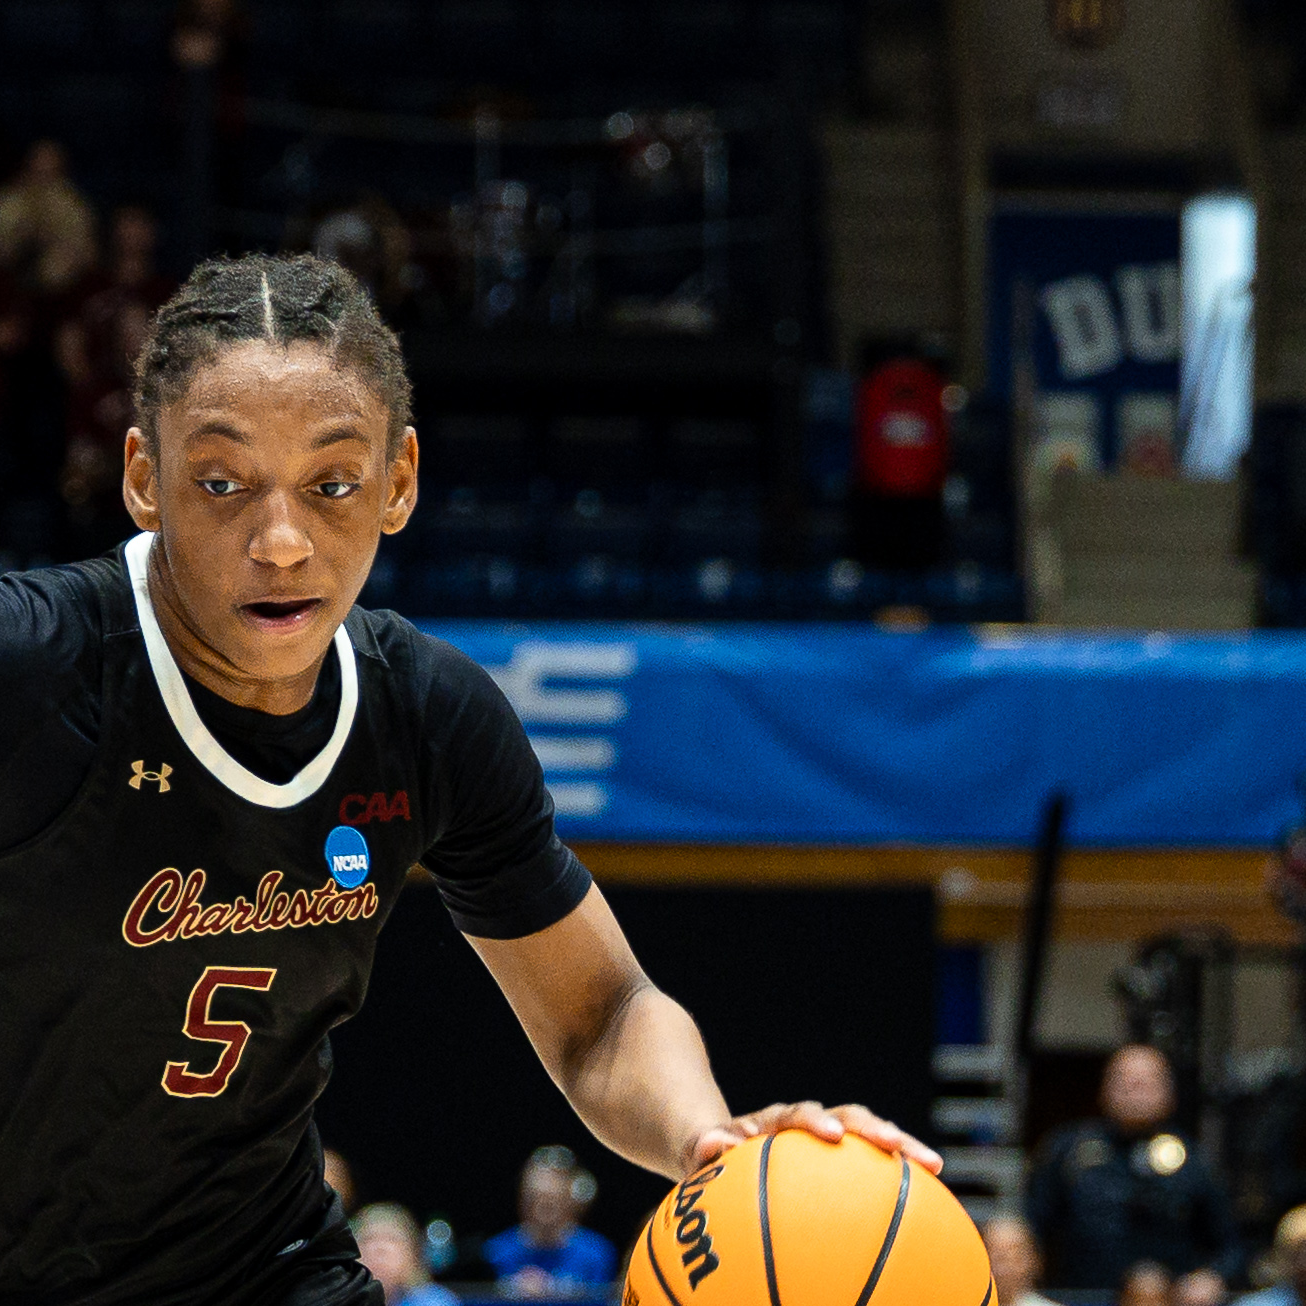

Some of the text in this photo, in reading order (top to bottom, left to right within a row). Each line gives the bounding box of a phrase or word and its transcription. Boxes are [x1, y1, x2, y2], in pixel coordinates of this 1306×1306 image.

[338, 790, 411, 826] CAA
[332, 854, 368, 872] NCAA
[122, 867, 378, 947] Charleston
[160, 965, 277, 1098] 5
[673, 1163, 726, 1293] lson
